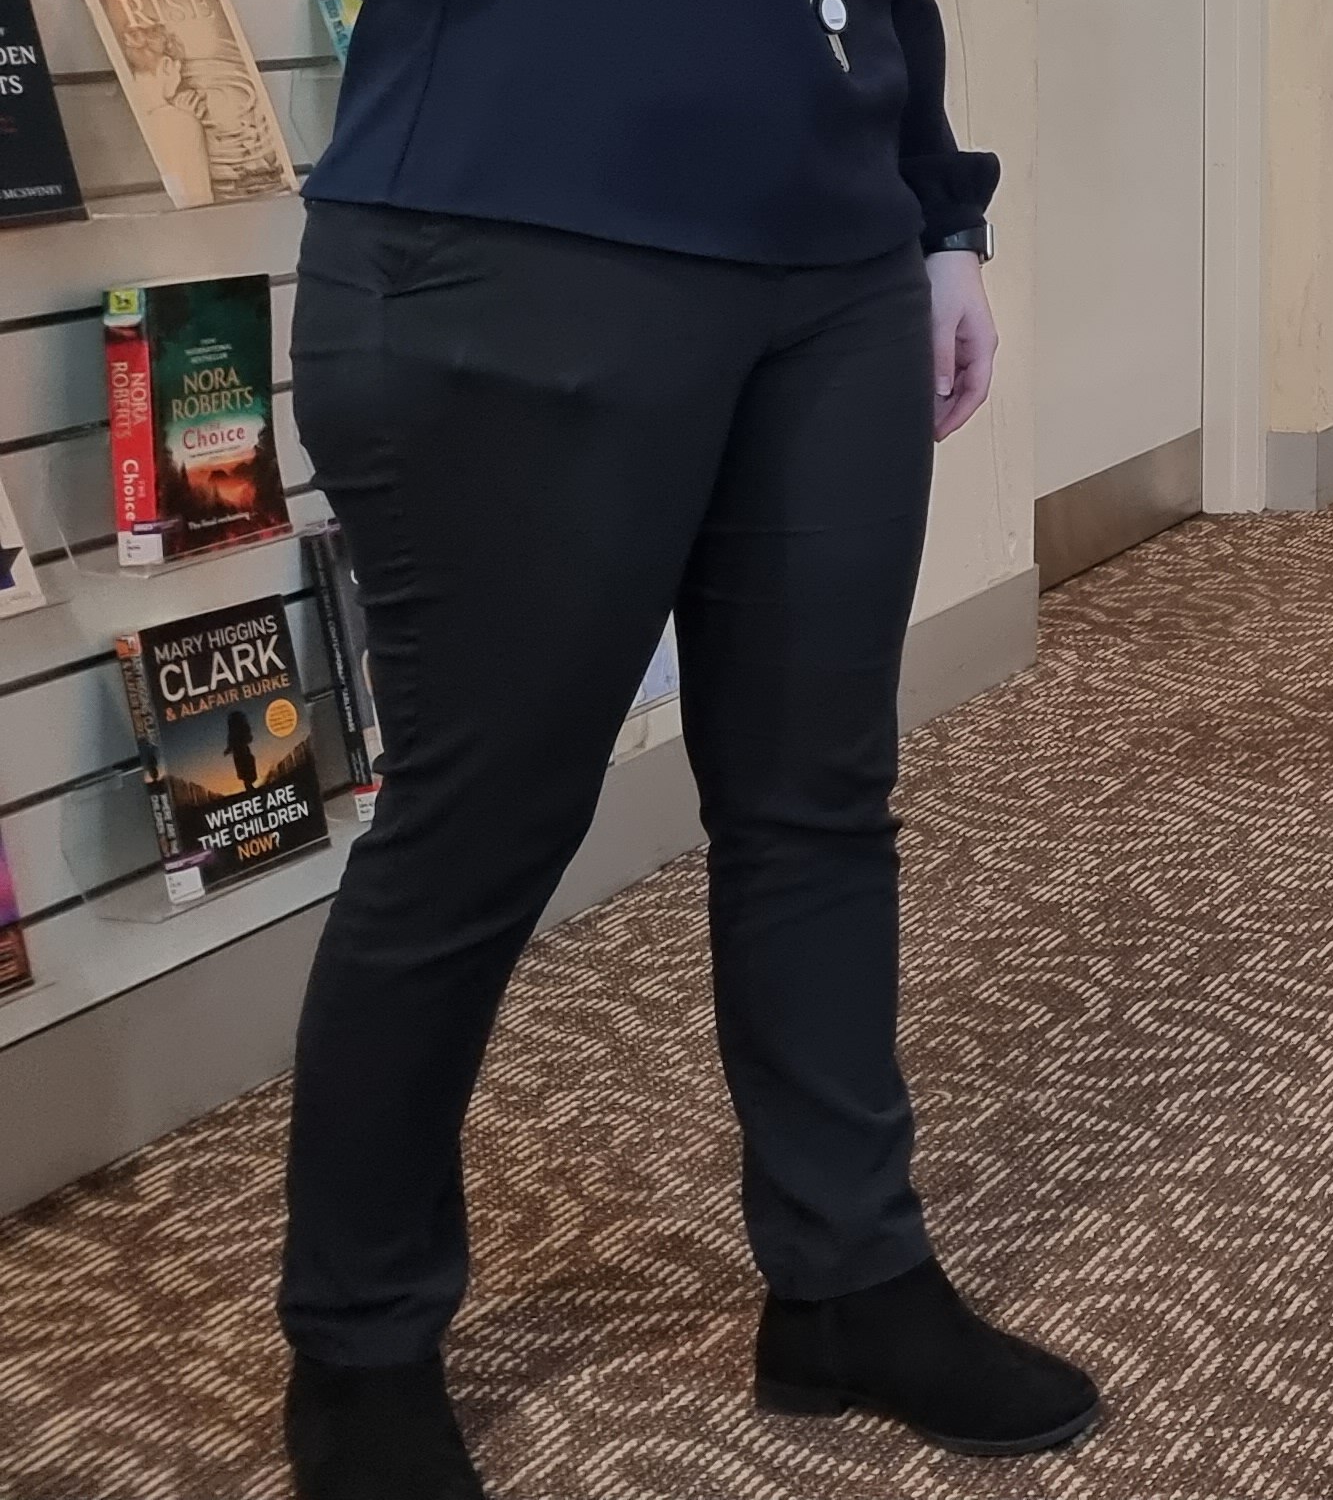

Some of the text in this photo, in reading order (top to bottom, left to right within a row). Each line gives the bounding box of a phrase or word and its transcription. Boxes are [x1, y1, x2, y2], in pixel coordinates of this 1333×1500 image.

[112, 361, 130, 439] ROBERTS
[131, 372, 148, 427] NORA
[172, 386, 254, 422] ROBERTS
[182, 366, 240, 396] NORA
[182, 425, 246, 450] Choice
[122, 459, 136, 522] Choice
[154, 614, 278, 663] MARY HIGGINS
[159, 635, 286, 703] CLARK
[165, 706, 178, 722] &
[180, 690, 239, 718] ALAFAIR
[243, 673, 291, 700] BURKE
[198, 801, 309, 851] THE CHILDREN
[205, 796, 262, 830] WHERE
[266, 784, 297, 809] ARE
[236, 831, 281, 861] NOW?
